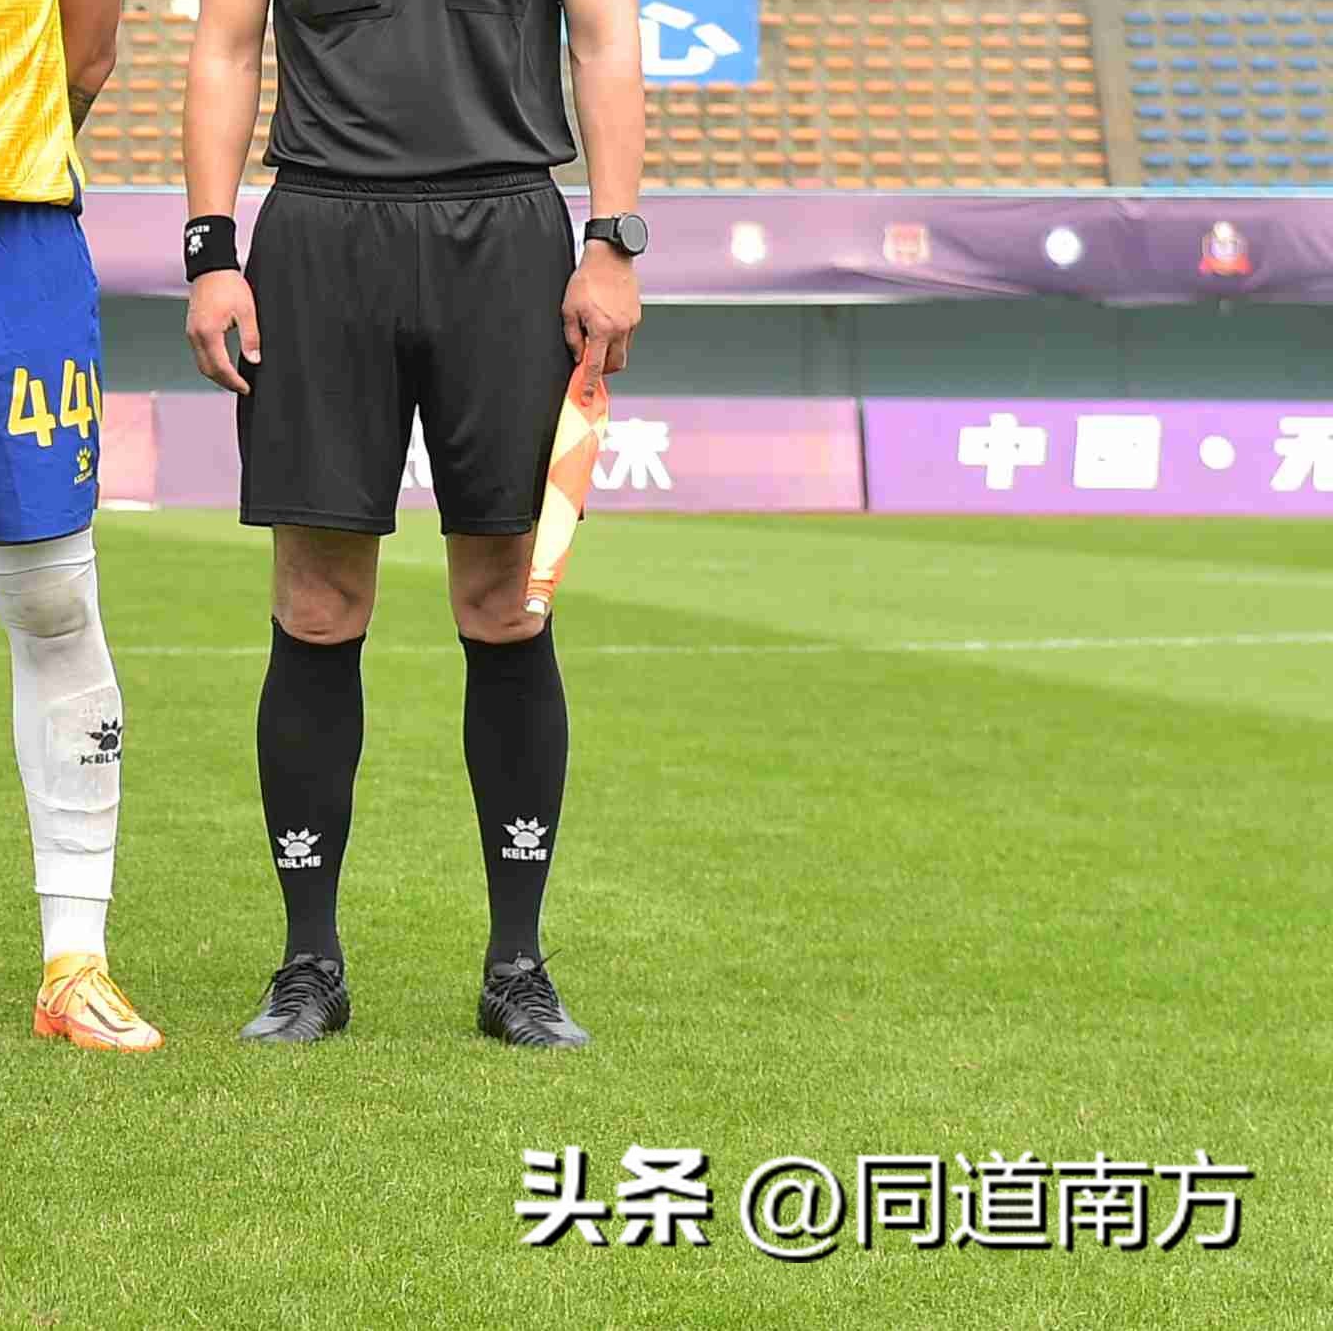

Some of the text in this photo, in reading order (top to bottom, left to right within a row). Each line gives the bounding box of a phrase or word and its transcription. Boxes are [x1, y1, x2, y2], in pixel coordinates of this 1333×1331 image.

[7, 358, 93, 448] 44
[80, 751, 122, 766] KELM
[501, 847, 547, 861] KELME
[277, 855, 322, 868] KELME
